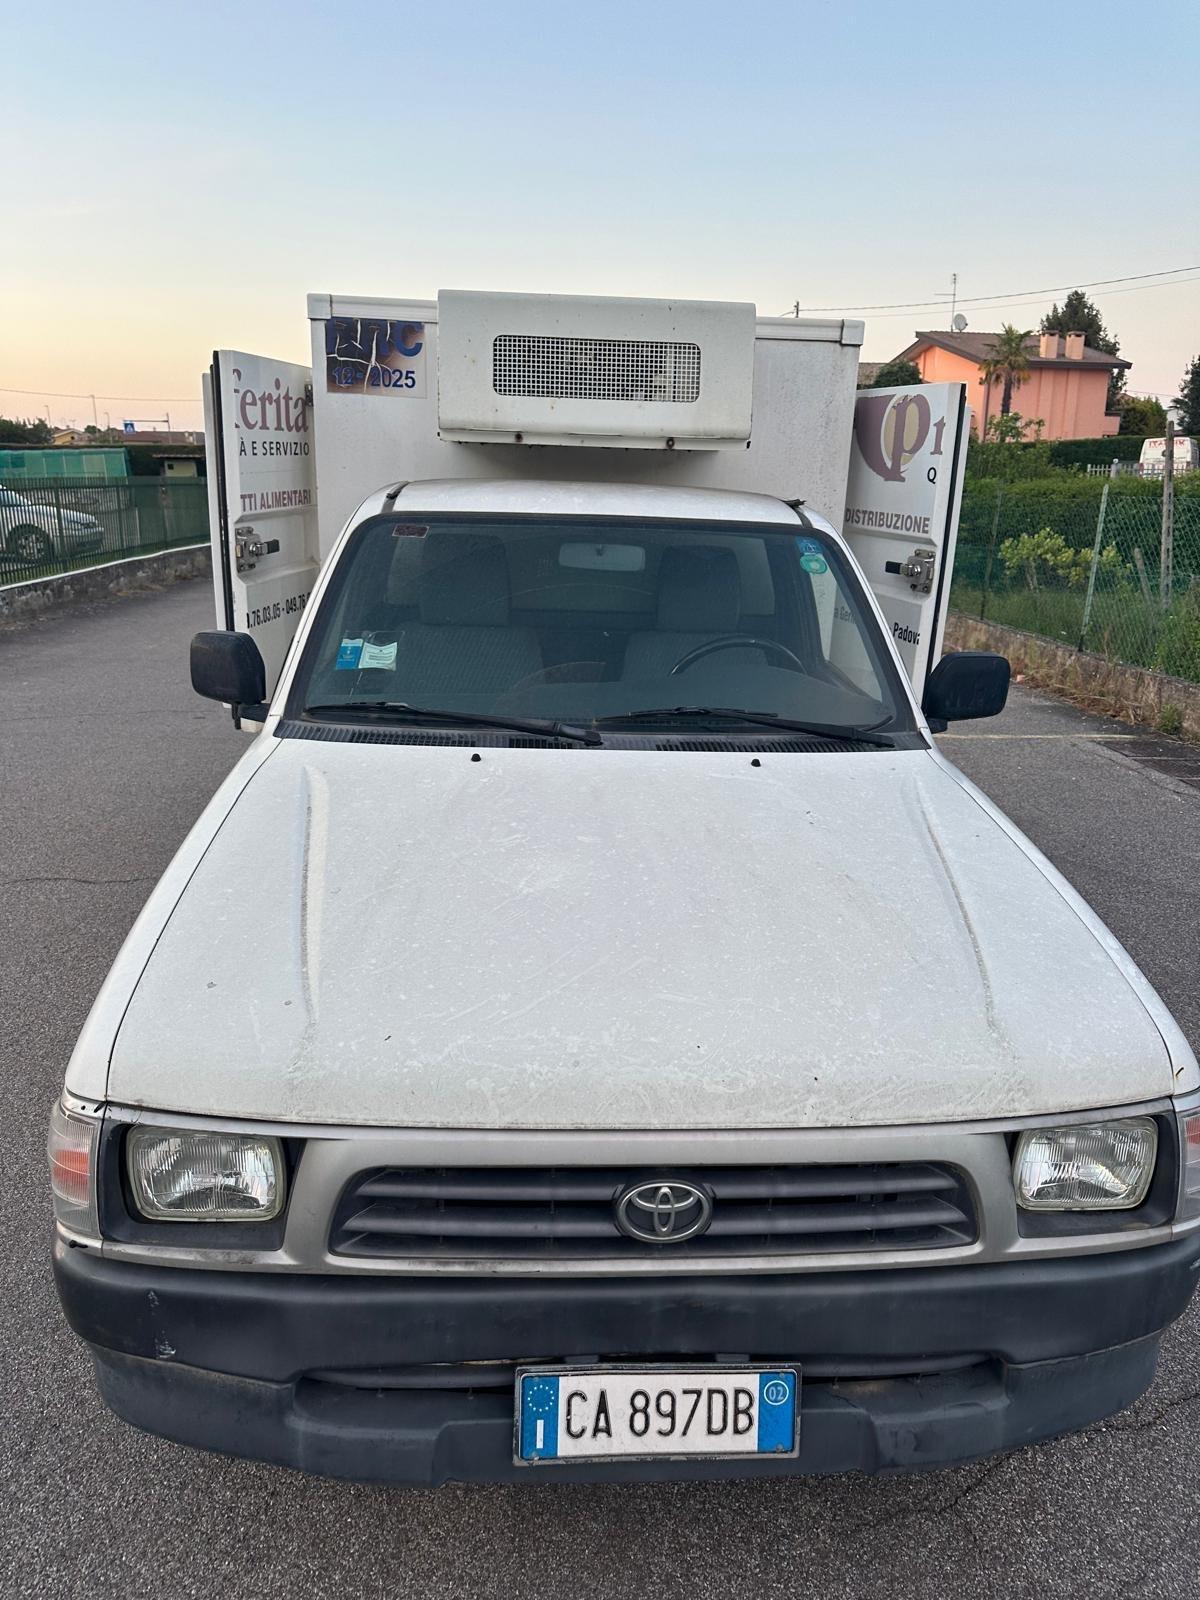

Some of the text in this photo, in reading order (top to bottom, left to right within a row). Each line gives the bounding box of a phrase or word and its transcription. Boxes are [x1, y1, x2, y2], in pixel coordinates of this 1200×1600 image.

[371, 368, 417, 388] 2025
[251, 441, 258, 457] E
[262, 441, 310, 456] SERVIZIO
[927, 467, 937, 484] Q
[240, 487, 311, 512] TTI ALIMENTARI
[844, 508, 931, 535] DISTRIBUZIONE
[565, 1389, 612, 1439] CA
[629, 1387, 755, 1437] 897DB
[768, 1386, 785, 1401] 02
